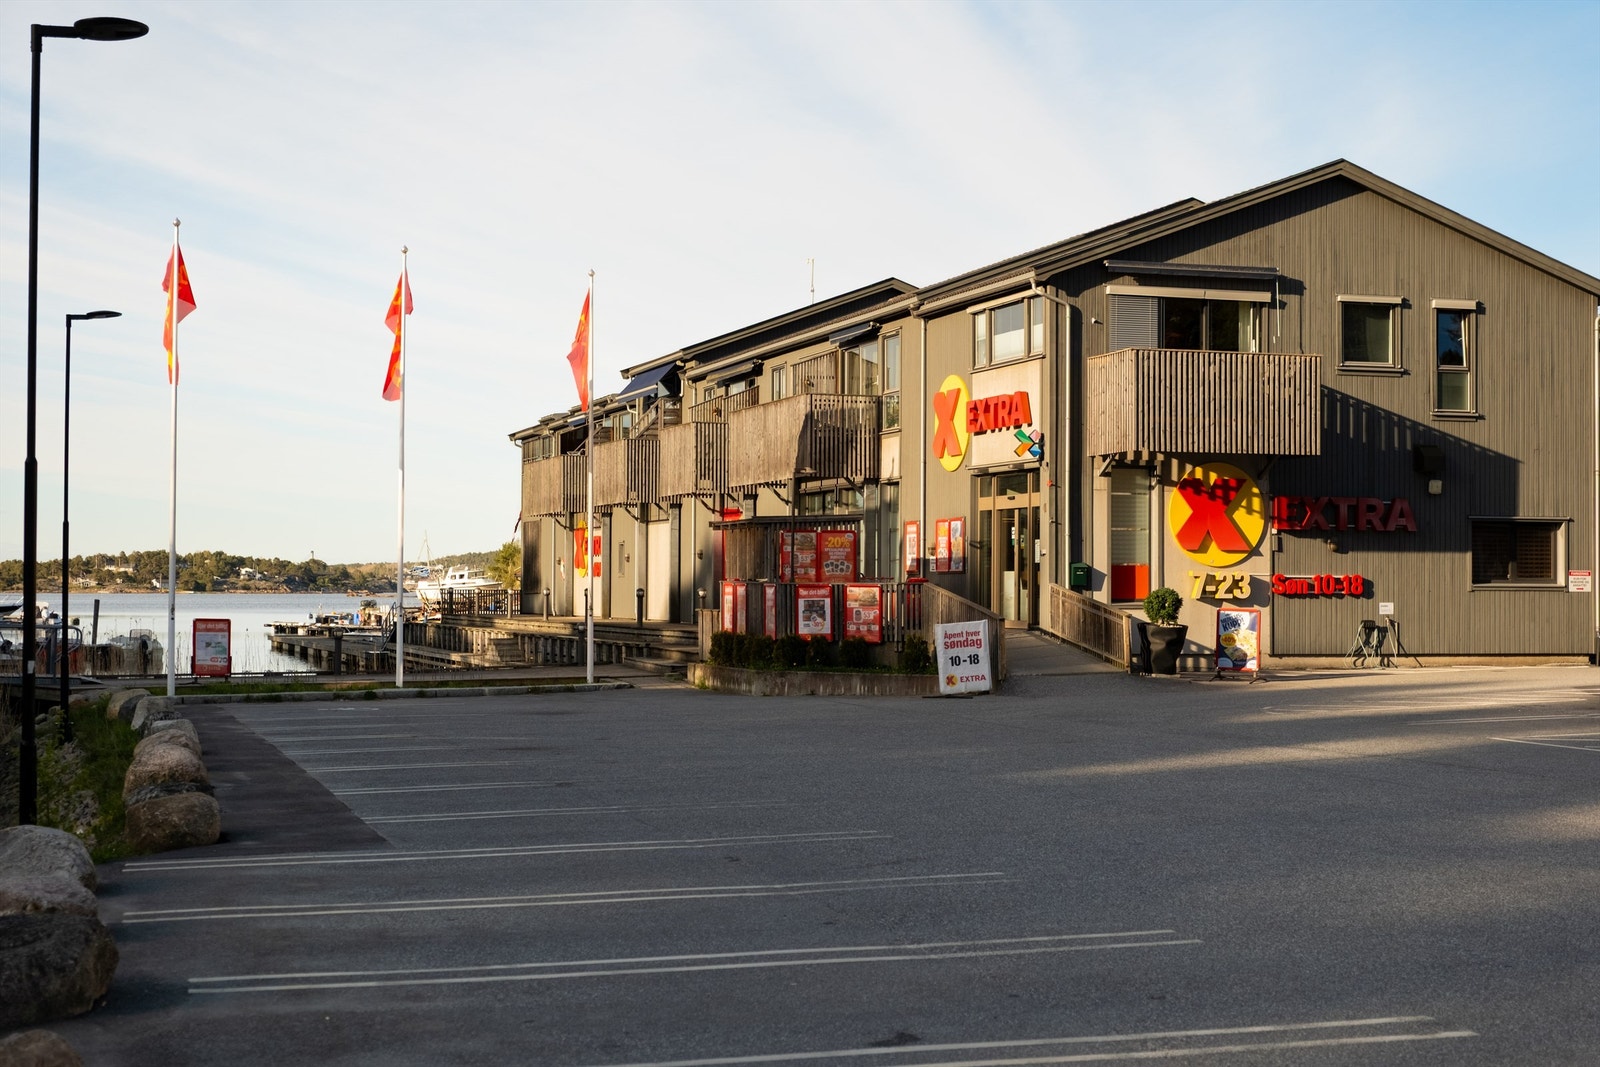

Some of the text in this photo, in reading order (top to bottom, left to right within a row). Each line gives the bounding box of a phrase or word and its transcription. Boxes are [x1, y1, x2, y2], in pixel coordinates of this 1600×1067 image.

[933, 388, 962, 458] X
[966, 391, 1032, 433] EXTRA
[1176, 478, 1253, 551] X
[1273, 496, 1417, 532] EXTRA
[825, 536, 850, 548] -20%
[1188, 570, 1252, 600] 7-23
[1272, 573, 1364, 596] Søn 10-18
[943, 630, 981, 640] Åpent hver
[943, 638, 983, 650] søndag
[949, 653, 980, 667] 10-18
[960, 674, 987, 683] EXTRA
